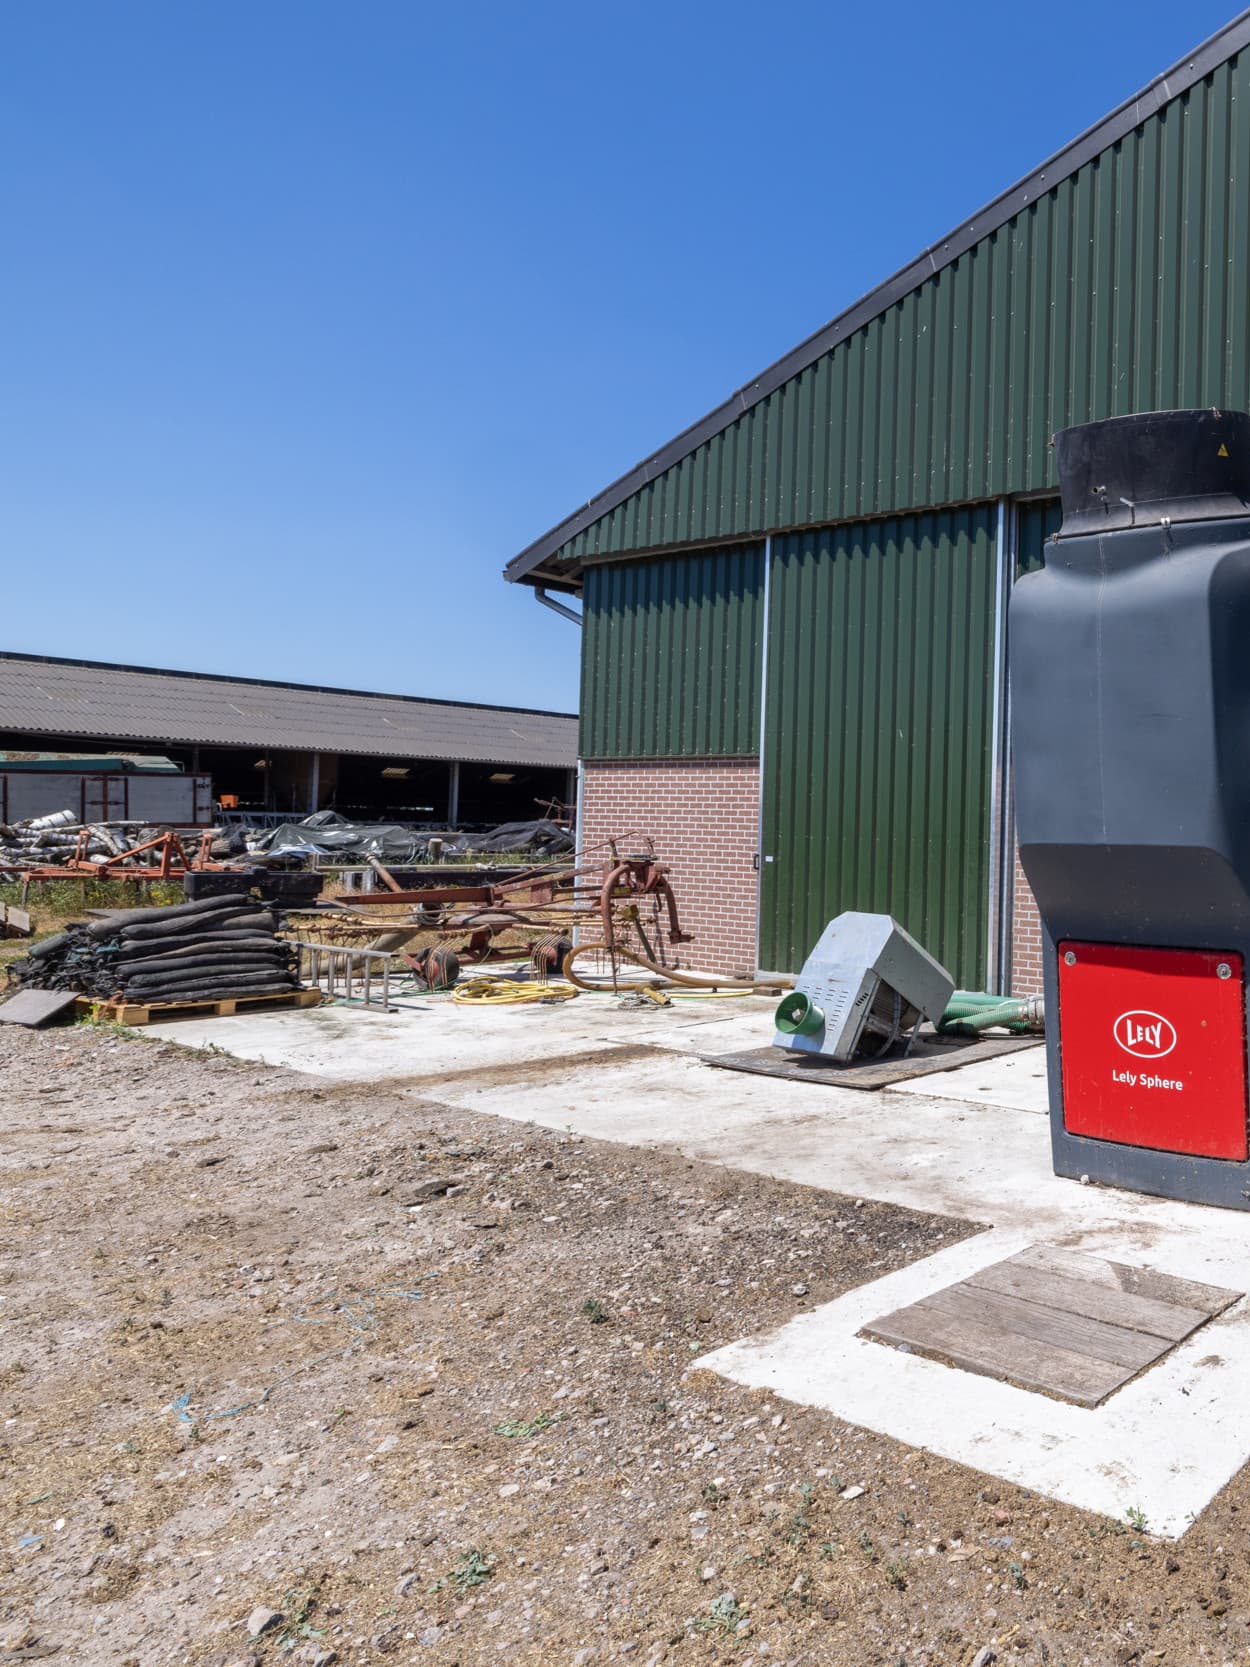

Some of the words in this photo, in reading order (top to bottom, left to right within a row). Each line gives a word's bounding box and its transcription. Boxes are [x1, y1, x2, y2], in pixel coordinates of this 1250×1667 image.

[1126, 1018, 1162, 1049] LELY
[1112, 1069, 1137, 1086] Lely
[1139, 1074, 1183, 1091] Sphere
